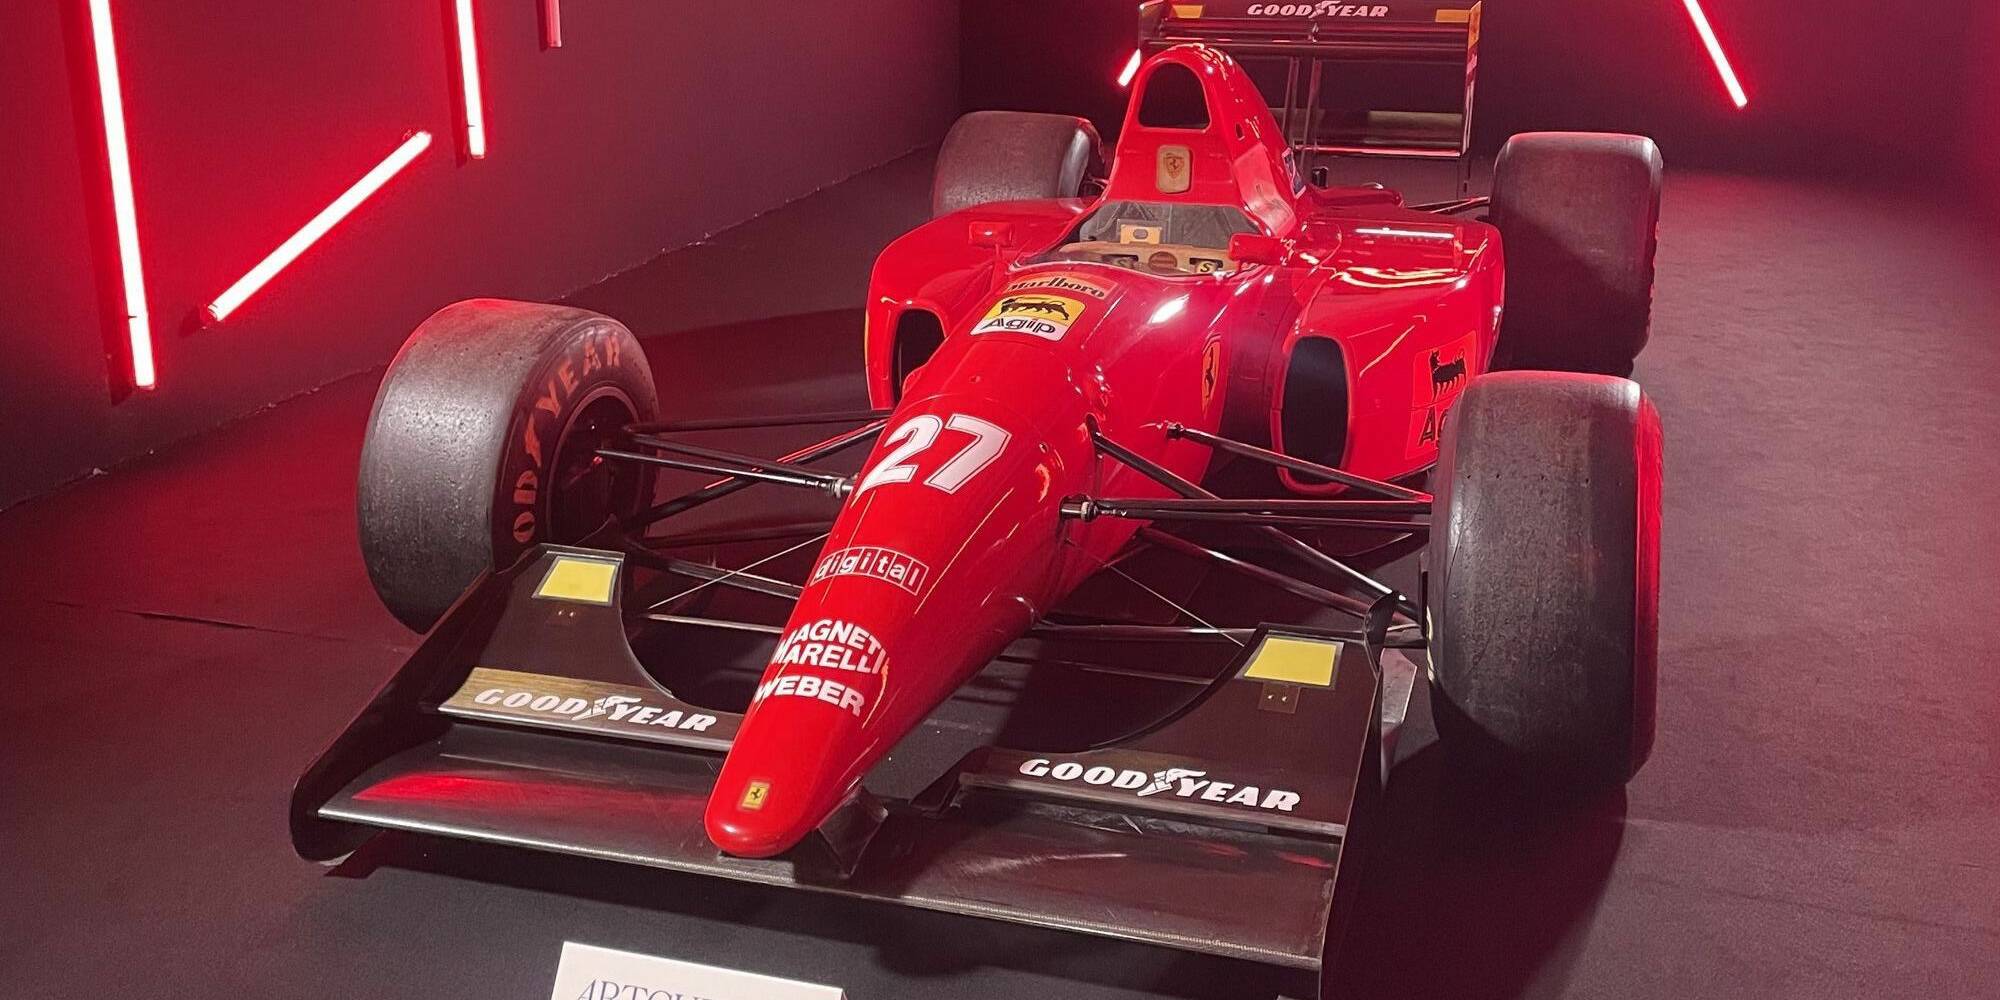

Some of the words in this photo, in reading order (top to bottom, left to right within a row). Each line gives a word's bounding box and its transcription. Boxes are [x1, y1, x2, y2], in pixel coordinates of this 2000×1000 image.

[1247, 2, 1388, 17] GOODYEAR
[980, 317, 1056, 334] Agip
[850, 412, 1012, 508] 27
[815, 551, 920, 587] digital
[474, 687, 718, 732] GOODYEAR
[752, 674, 866, 718] WEBER
[1019, 758, 1301, 812] GOODYEAR
